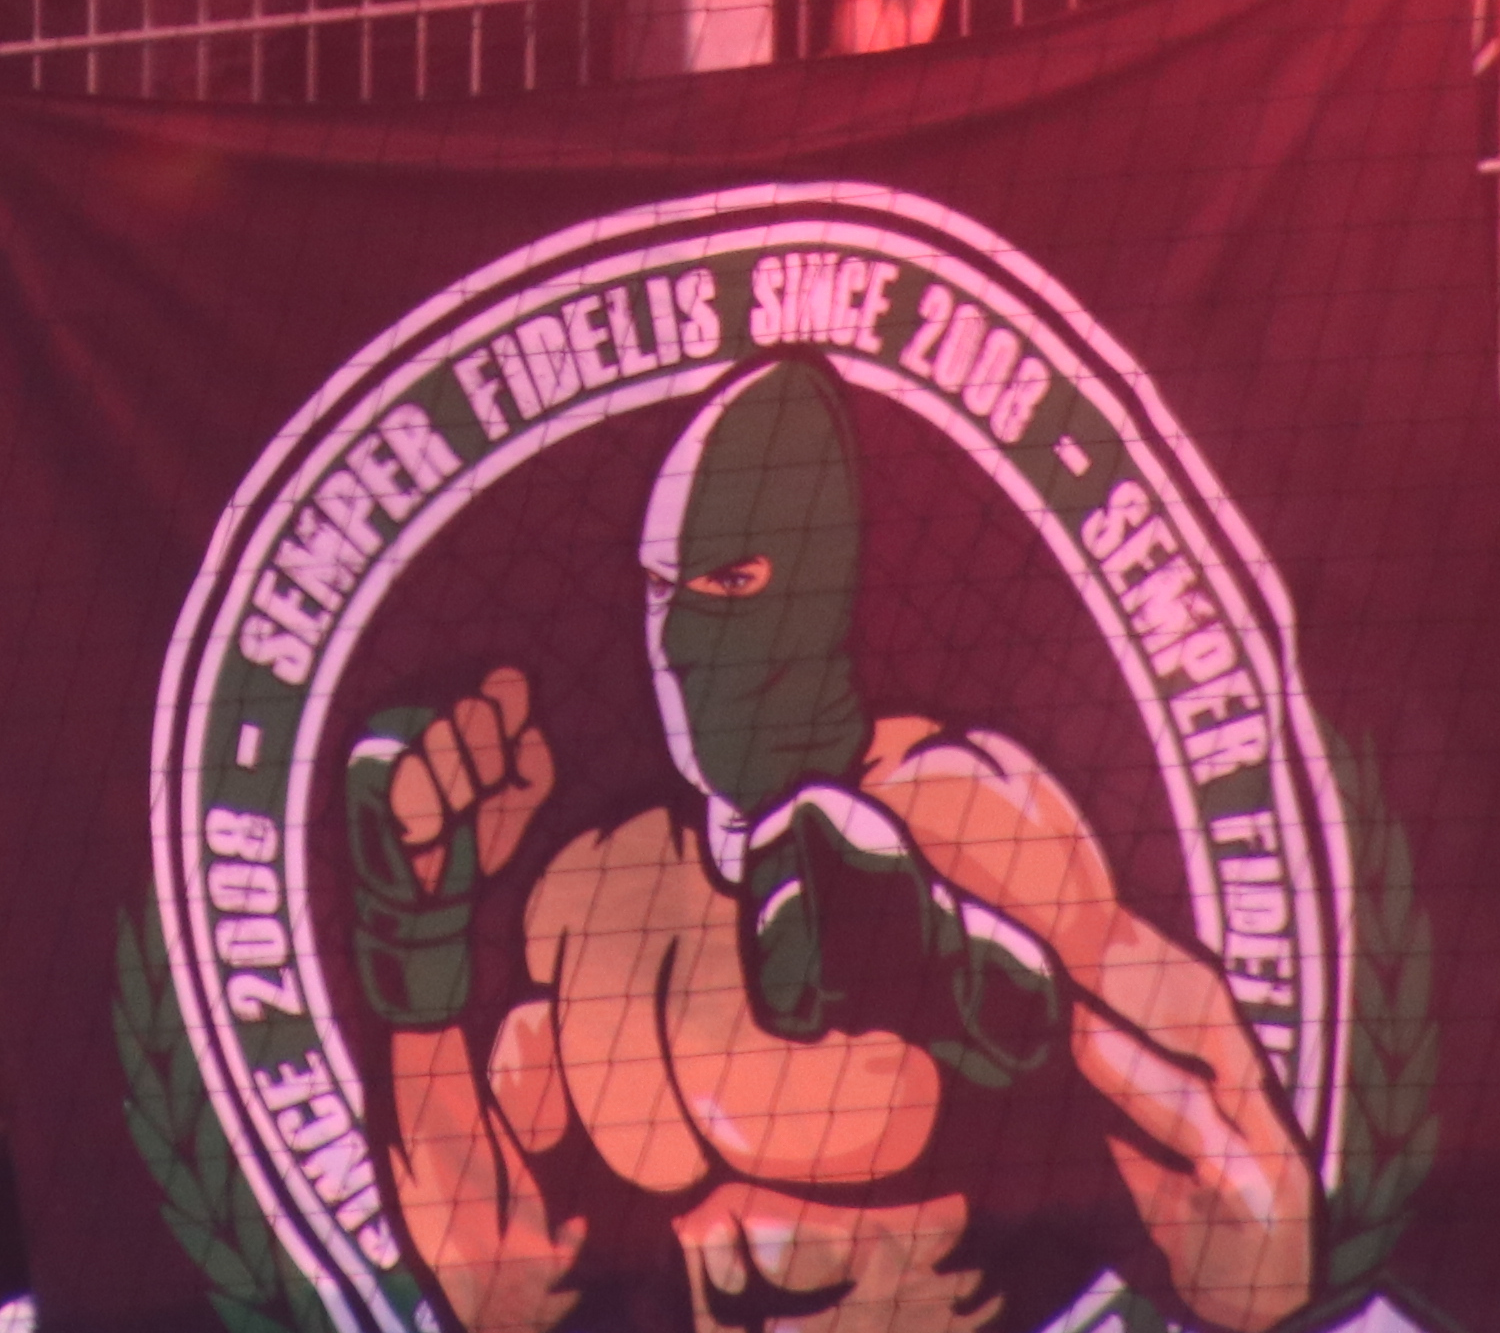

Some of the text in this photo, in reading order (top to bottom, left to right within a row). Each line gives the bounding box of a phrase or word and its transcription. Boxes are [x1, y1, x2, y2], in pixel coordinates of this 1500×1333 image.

[452, 268, 721, 441] FIDELIS
[750, 252, 898, 354] SINCE
[901, 284, 1051, 444] 2008
[240, 402, 463, 686] SEMPER
[1081, 479, 1270, 785] SEMPER
[206, 807, 304, 1022] 2008
